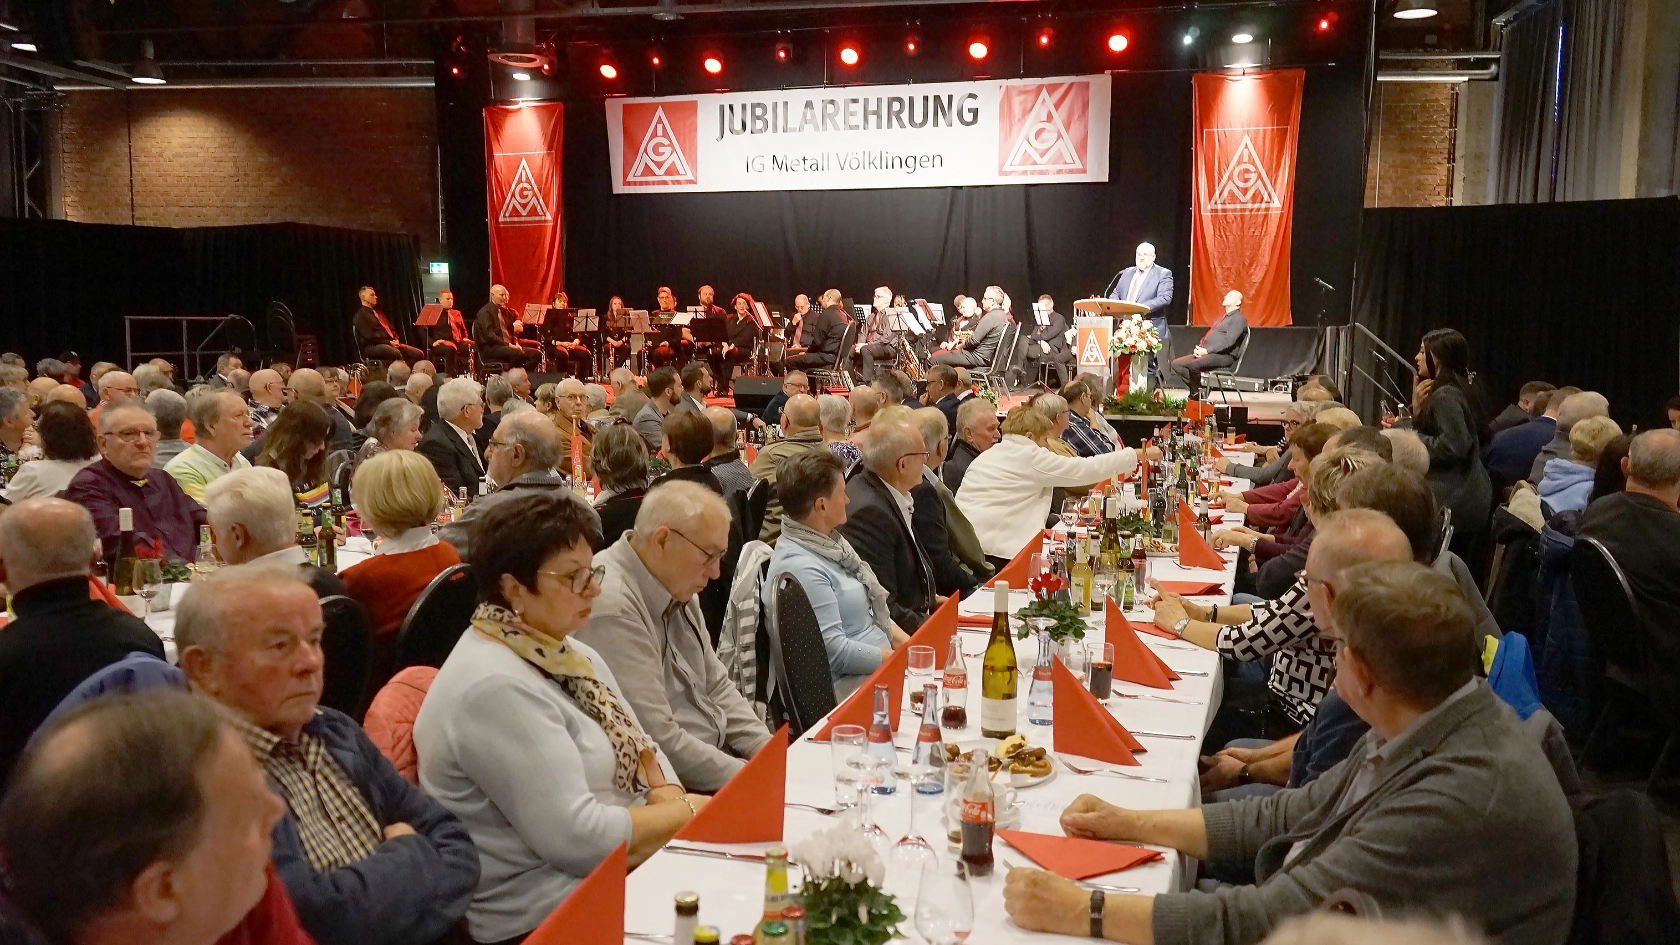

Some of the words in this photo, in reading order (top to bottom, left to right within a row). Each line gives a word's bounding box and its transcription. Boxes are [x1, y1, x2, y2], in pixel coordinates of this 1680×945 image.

[716, 92, 979, 142] JUBILAREHRUNG
[746, 155, 765, 173] IG
[772, 152, 830, 173] Metall
[836, 151, 943, 174] Völklingen
